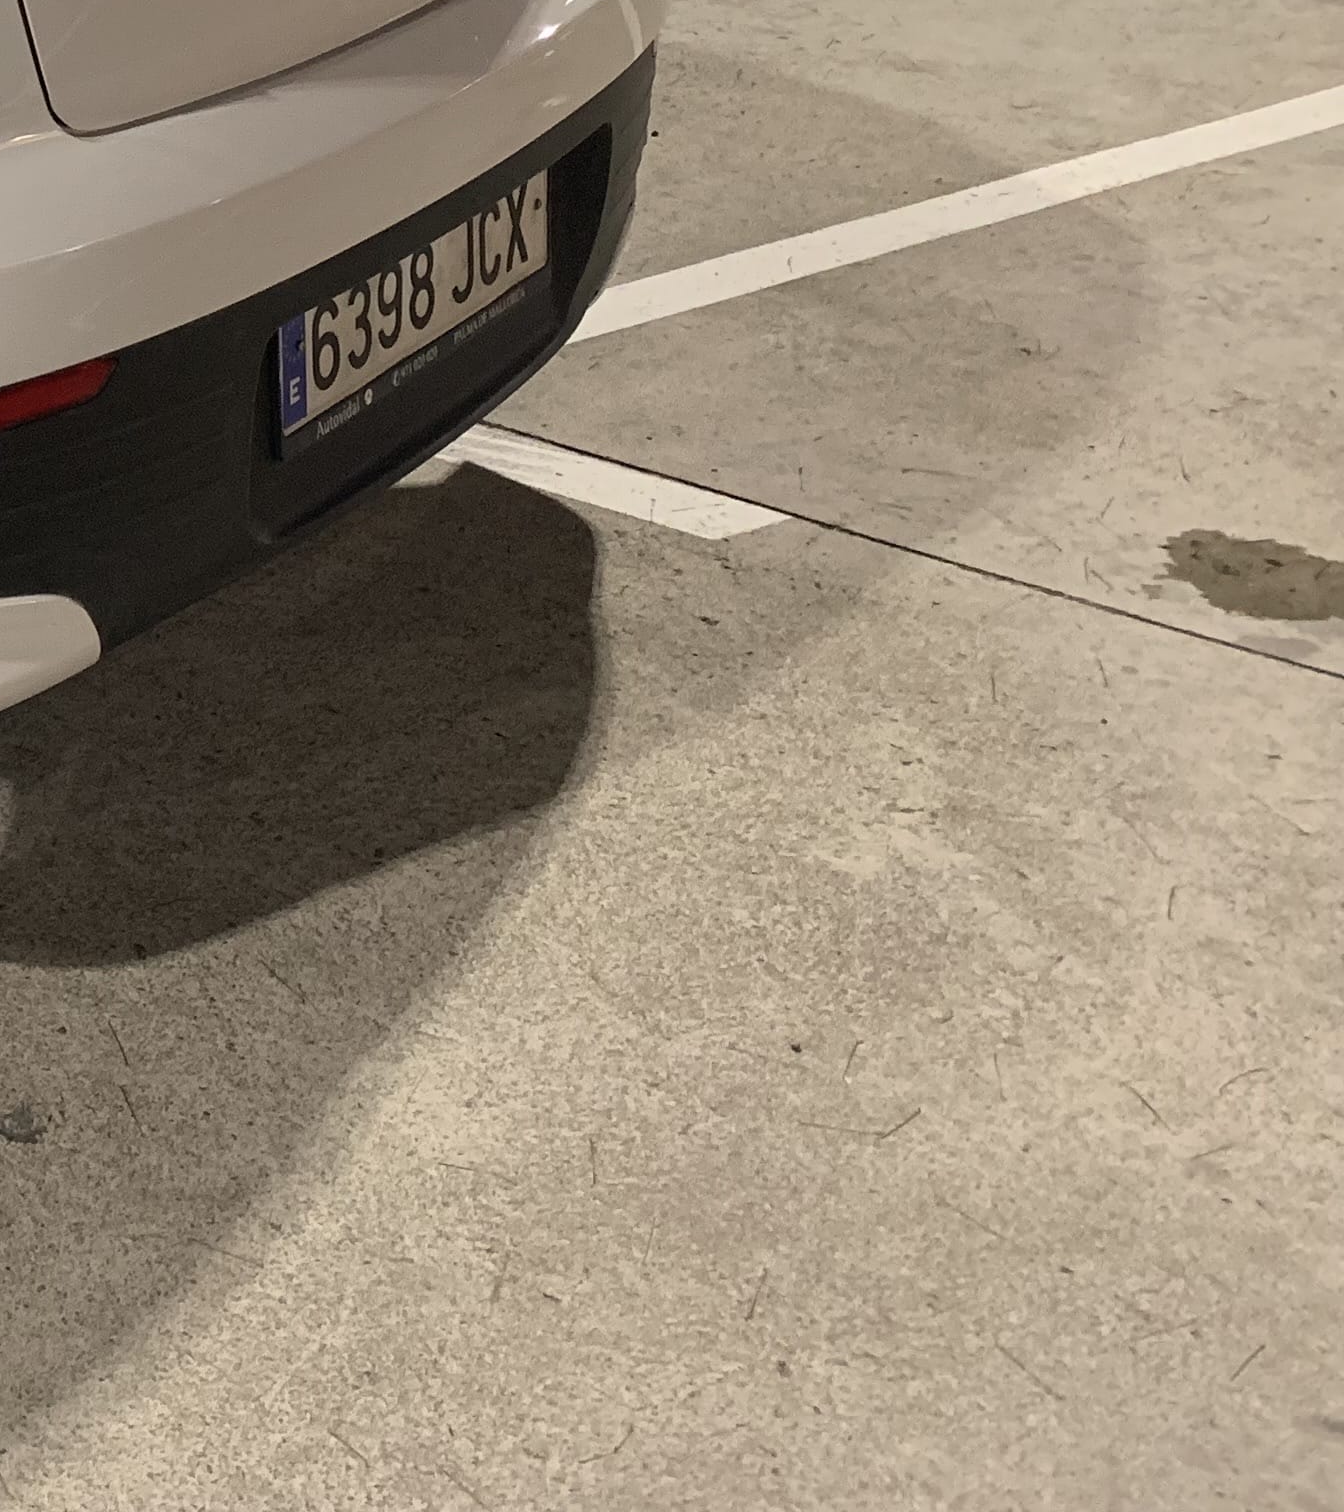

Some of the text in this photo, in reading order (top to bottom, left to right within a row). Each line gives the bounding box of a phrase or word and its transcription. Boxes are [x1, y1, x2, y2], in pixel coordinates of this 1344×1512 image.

[312, 243, 435, 391] 6398
[452, 184, 529, 303] JCX
[289, 375, 302, 406] E
